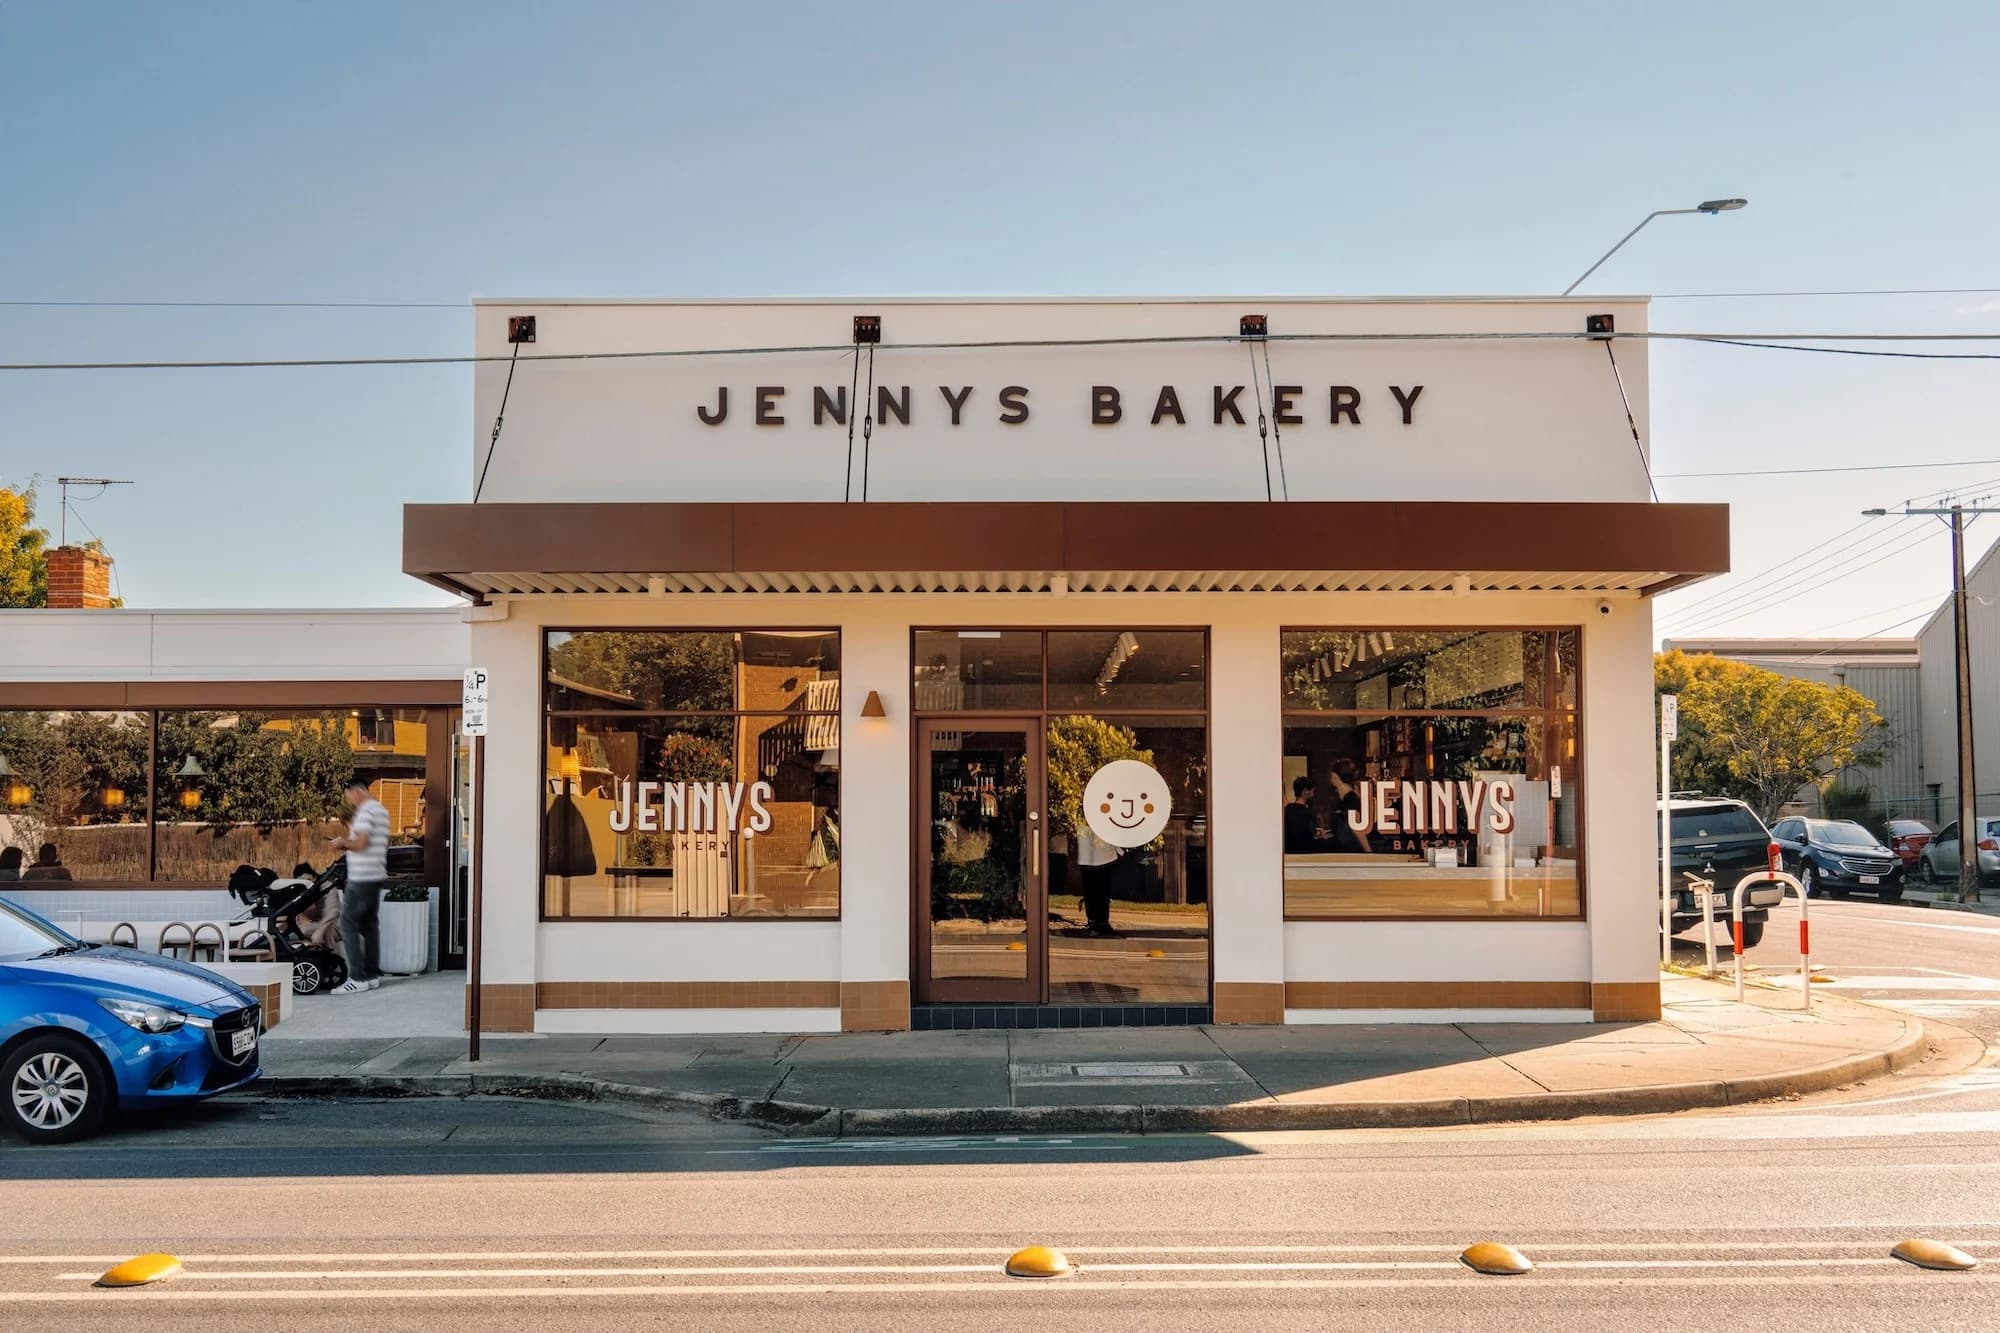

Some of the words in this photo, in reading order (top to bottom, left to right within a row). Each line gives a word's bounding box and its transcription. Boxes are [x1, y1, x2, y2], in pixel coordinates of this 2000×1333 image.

[697, 386, 1029, 425] JENNYS
[1092, 385, 1424, 425] BAKERY
[609, 781, 776, 835] JENNYS
[1121, 799, 1134, 819] J
[1347, 780, 1515, 835] JENNYS
[654, 841, 729, 851] BAKERY
